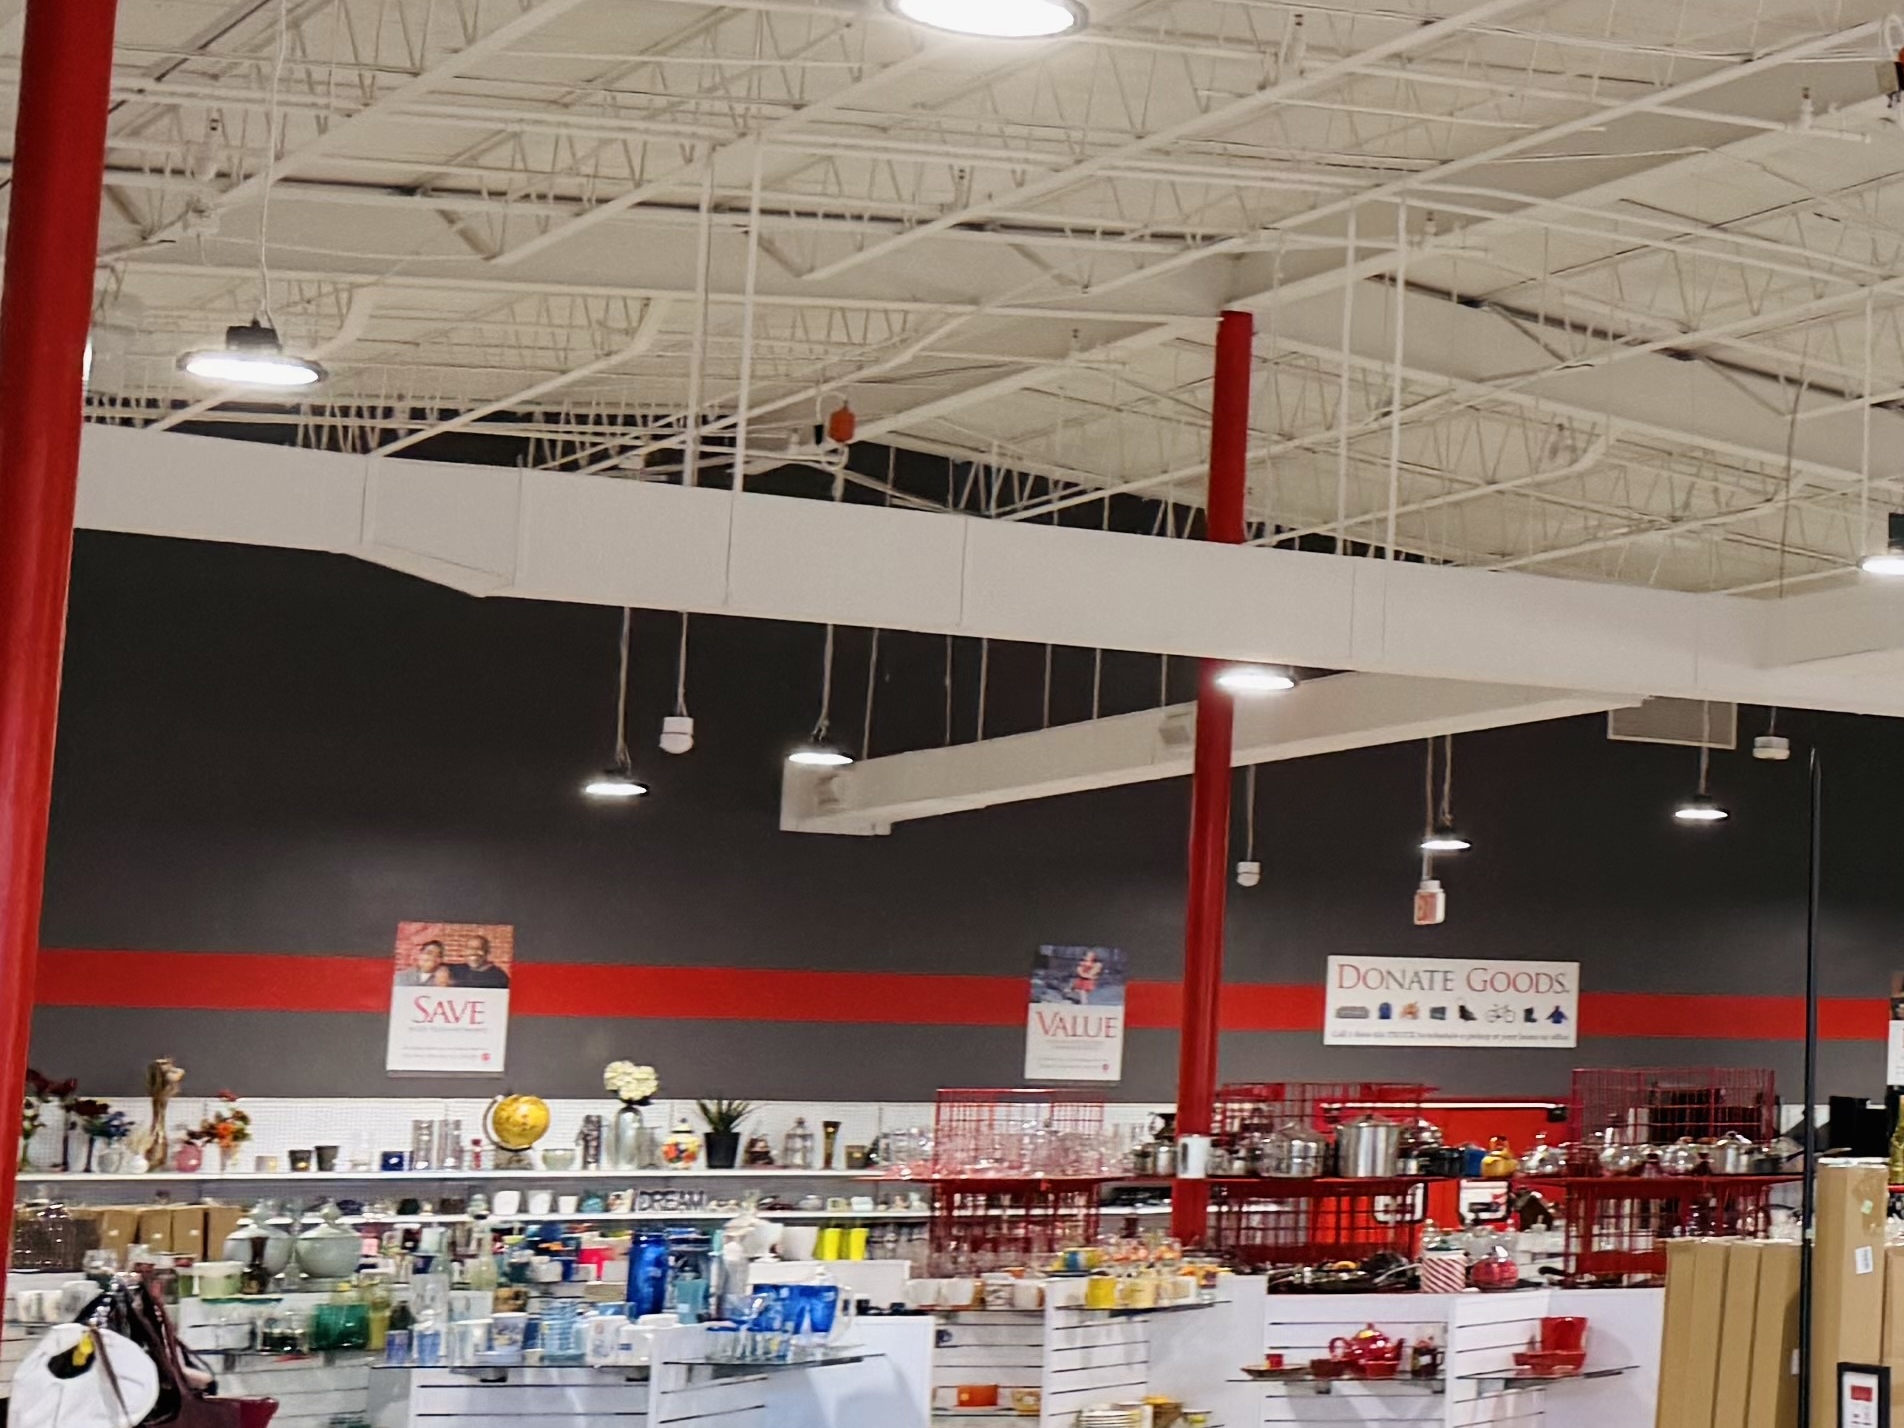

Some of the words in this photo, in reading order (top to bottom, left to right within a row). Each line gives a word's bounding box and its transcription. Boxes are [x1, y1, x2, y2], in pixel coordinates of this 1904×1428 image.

[1336, 963, 1456, 992] DONATE
[411, 994, 486, 1025] SAVE
[1036, 1010, 1119, 1039] VALUE
[635, 1189, 706, 1212] DREAM
